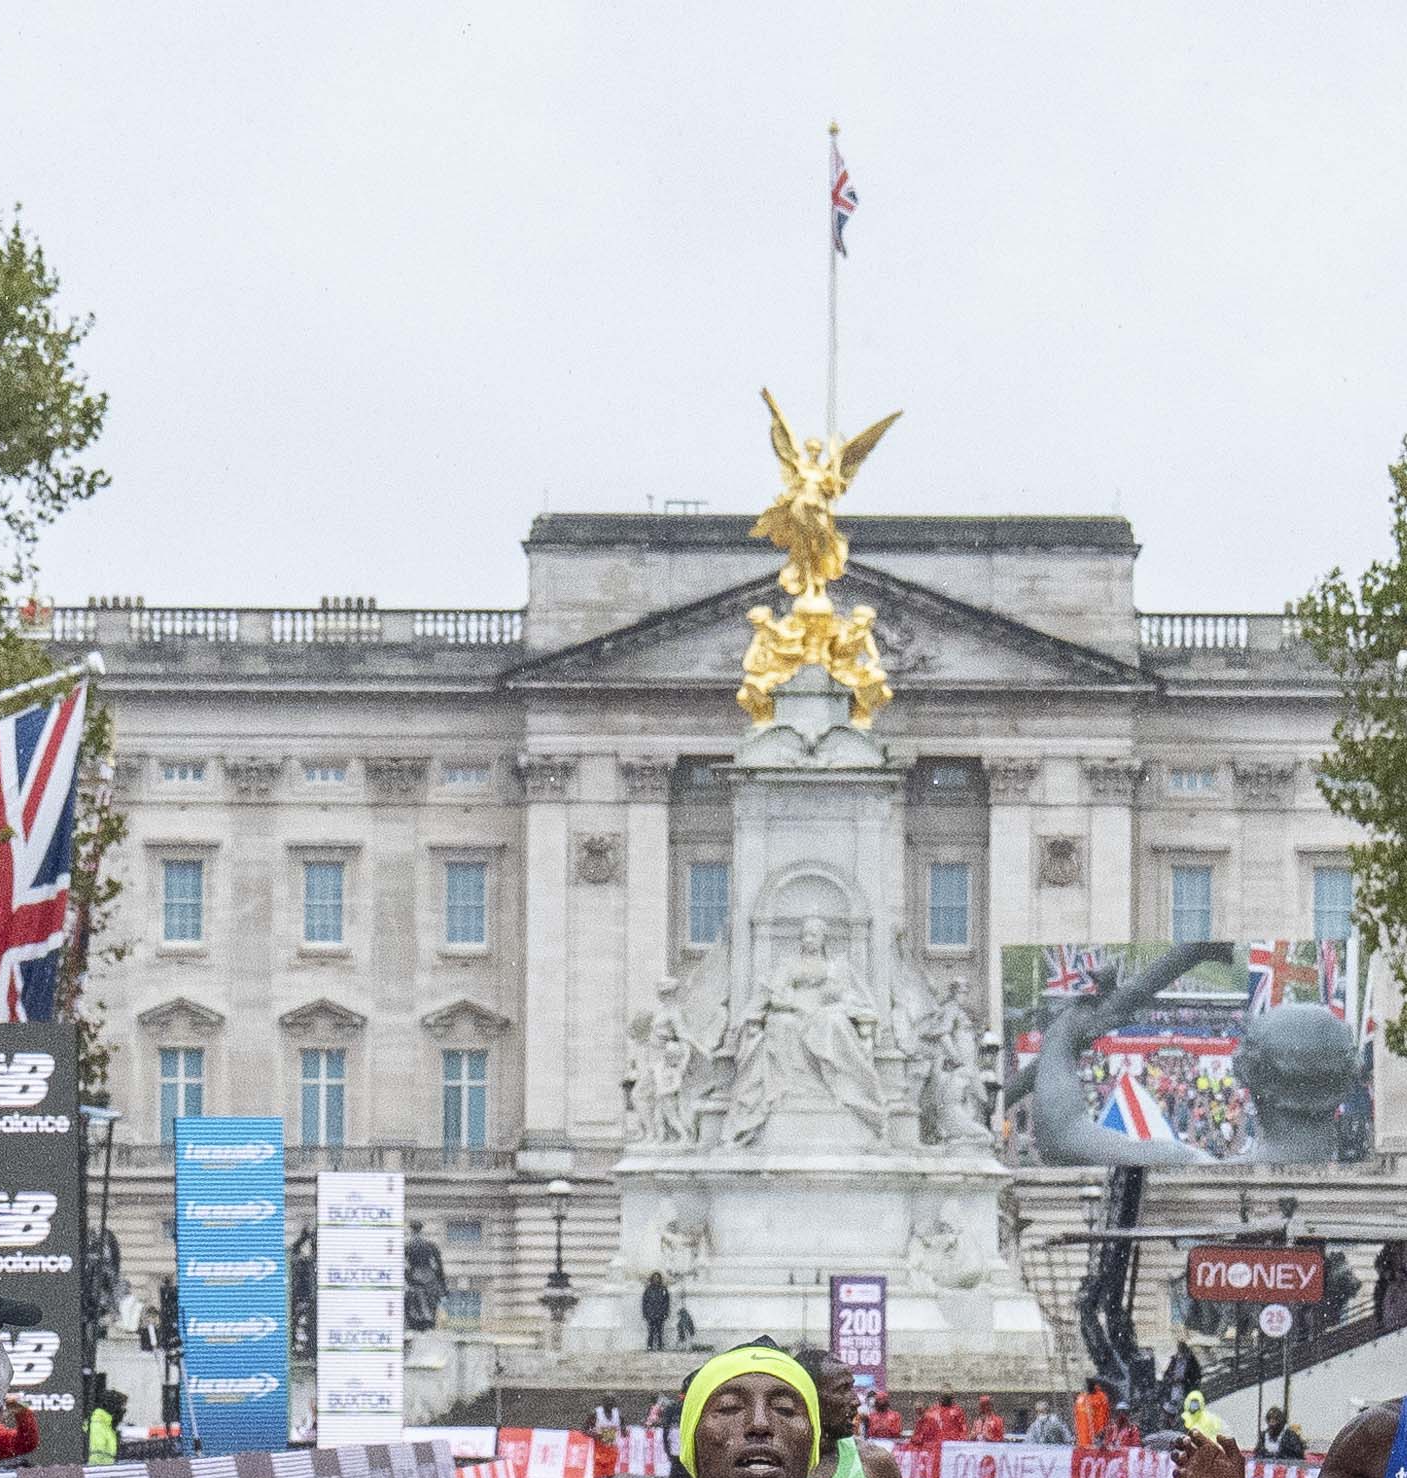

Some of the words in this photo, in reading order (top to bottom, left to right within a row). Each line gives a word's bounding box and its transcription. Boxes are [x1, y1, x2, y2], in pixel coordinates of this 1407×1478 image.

[1197, 1262, 1317, 1290] MONEY
[838, 1308, 882, 1335] 200
[860, 1349, 882, 1366] GO
[23, 1393, 75, 1411] ance
